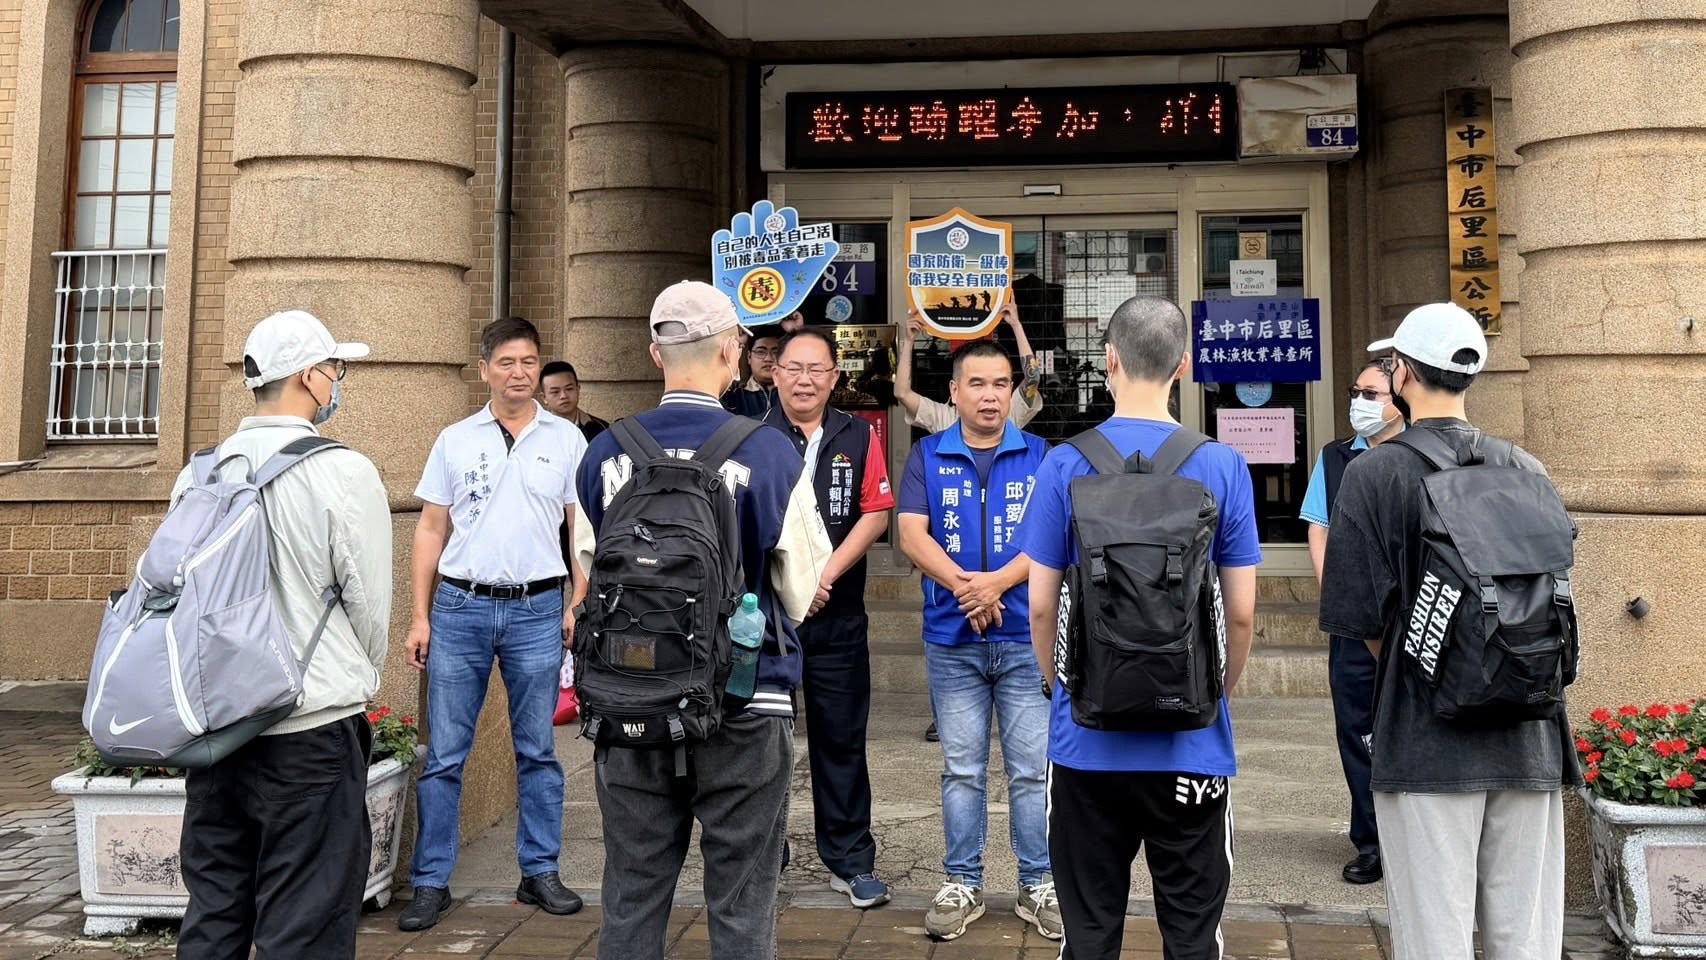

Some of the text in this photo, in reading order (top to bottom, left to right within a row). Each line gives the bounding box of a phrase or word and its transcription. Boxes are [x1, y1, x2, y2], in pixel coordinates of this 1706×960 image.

[1321, 128, 1343, 145] 84
[718, 225, 830, 254] 自己的人生自己活
[843, 244, 868, 253] 安路
[908, 254, 1008, 268] 國家防衛一級棒
[822, 264, 859, 292] 84
[908, 272, 1008, 287] 你我安全有保障
[1199, 319, 1313, 341] 臺中市后里區
[1199, 346, 1312, 363] 農林漁牧業普查所
[939, 466, 963, 475] KMT
[942, 488, 961, 553] 周永鴻
[1404, 570, 1441, 658] FASHION
[1420, 583, 1462, 676] INSIRER
[622, 723, 645, 734] WAU
